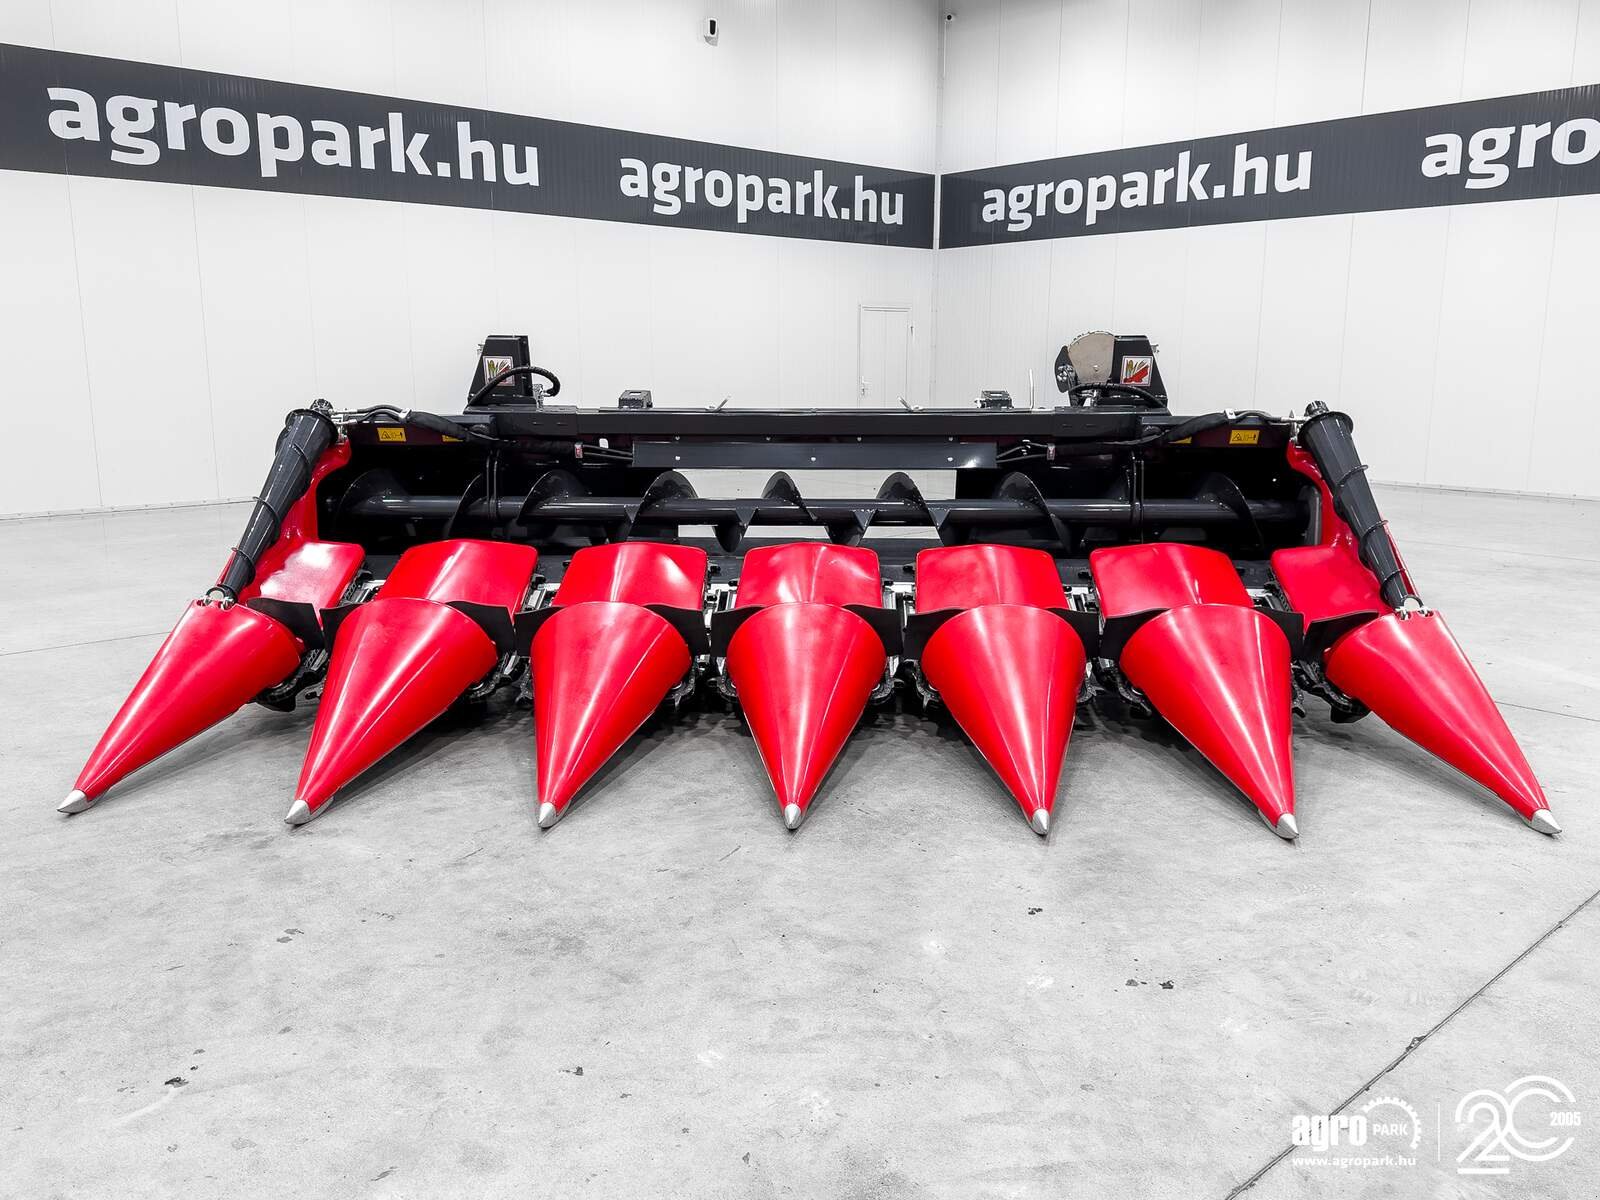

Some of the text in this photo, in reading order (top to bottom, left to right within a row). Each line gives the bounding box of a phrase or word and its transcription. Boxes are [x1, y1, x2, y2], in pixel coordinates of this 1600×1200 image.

[47, 87, 540, 187] agropark.hu
[619, 158, 904, 226] agropark.hu
[982, 143, 1312, 232] agropark.hu
